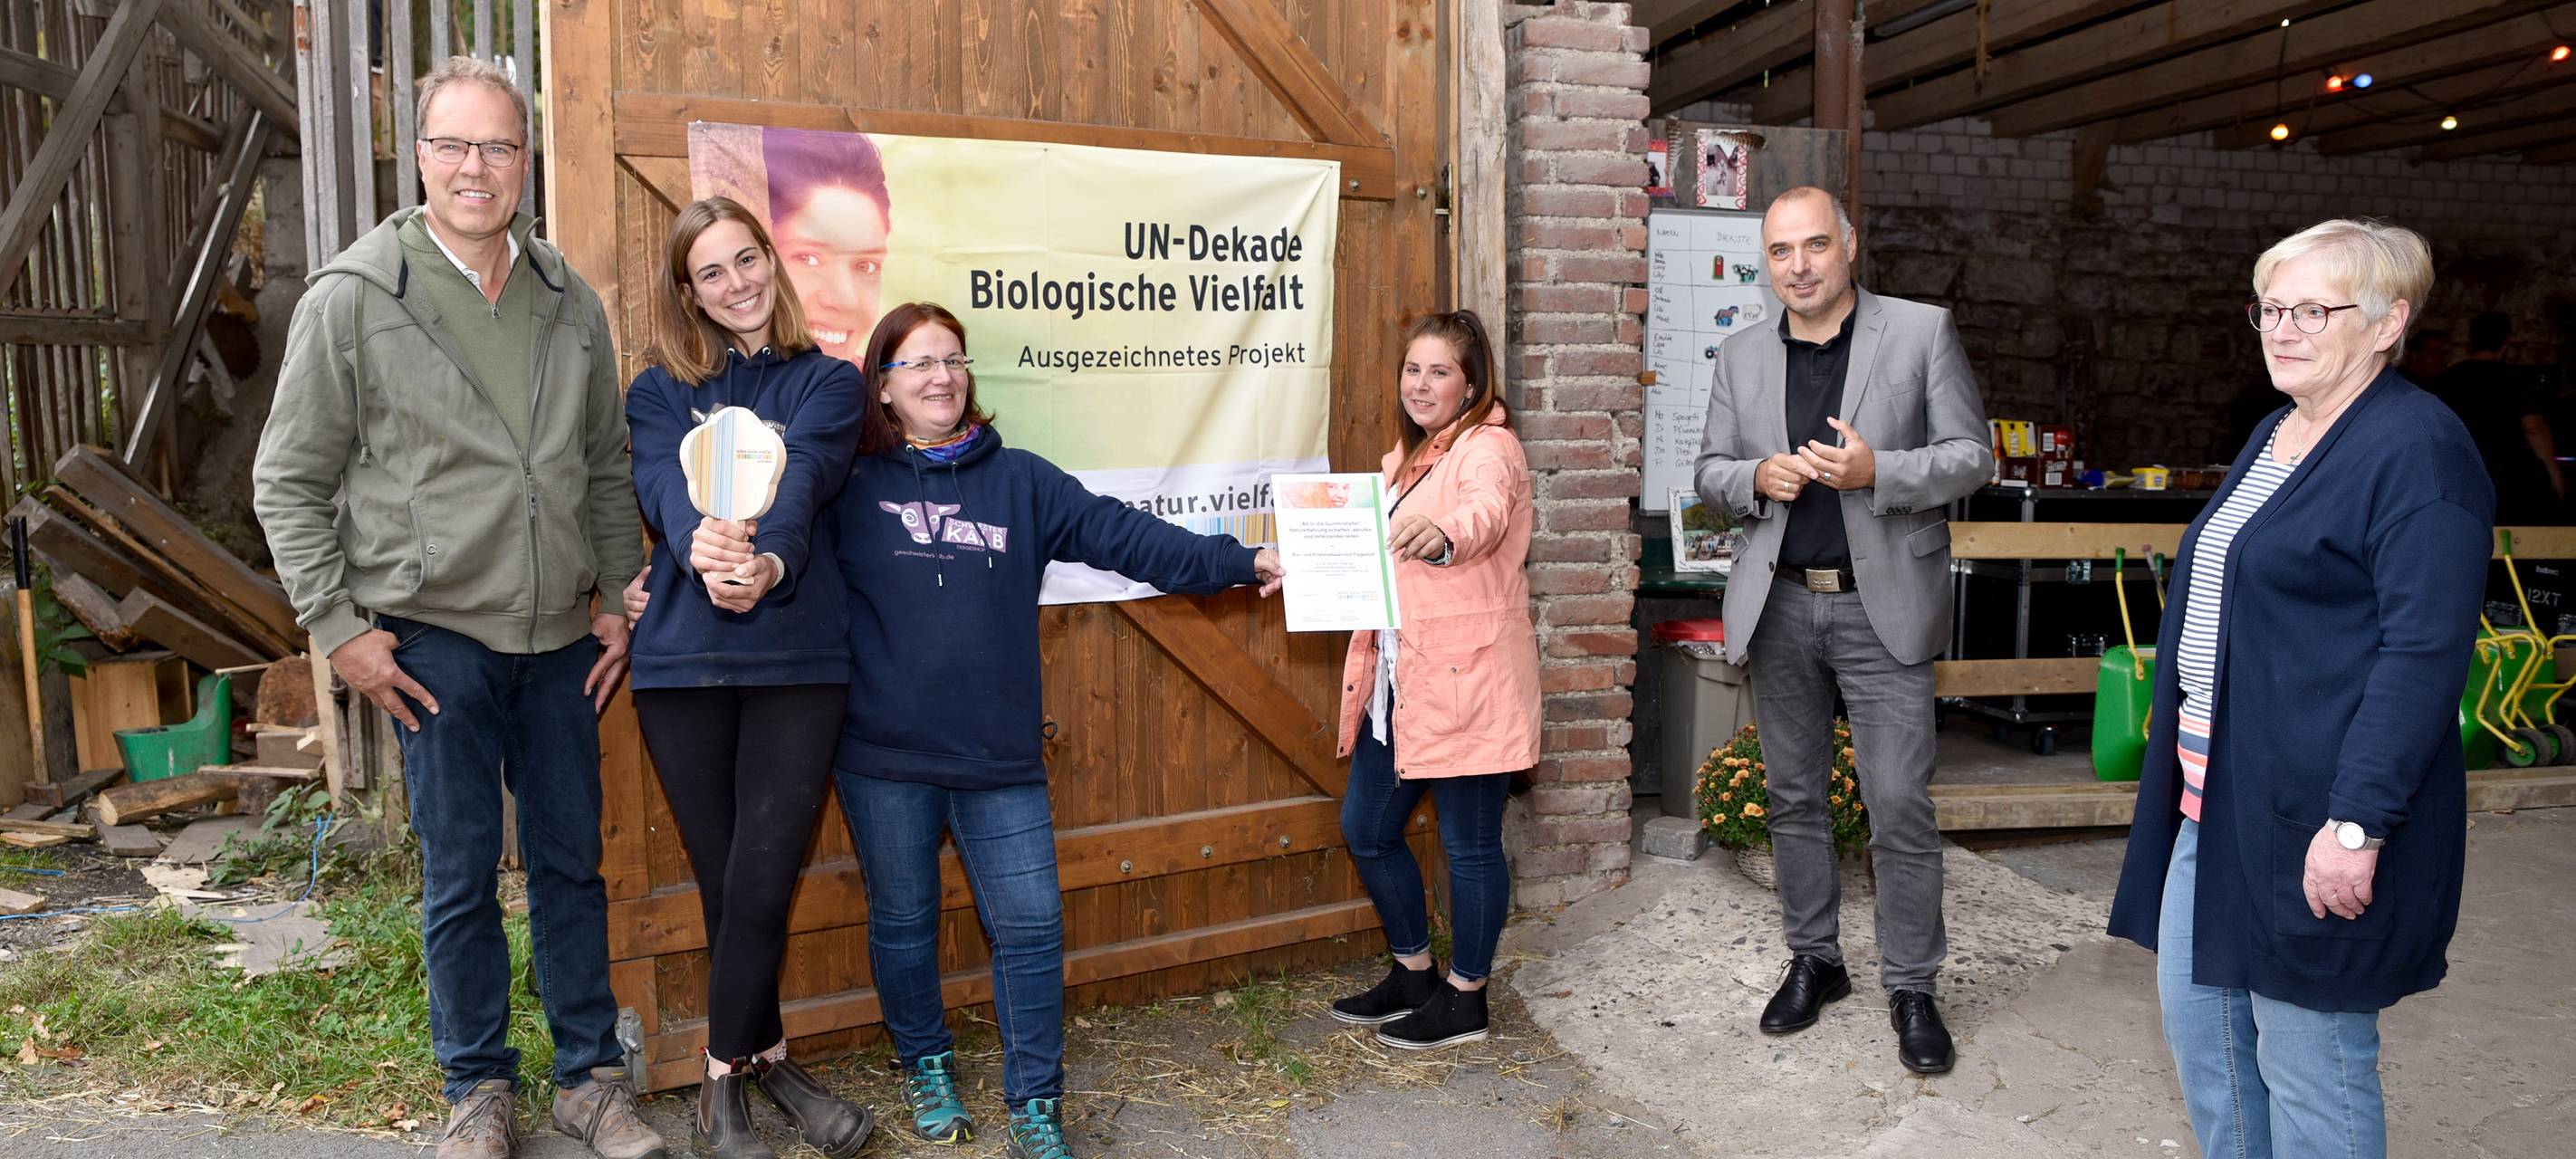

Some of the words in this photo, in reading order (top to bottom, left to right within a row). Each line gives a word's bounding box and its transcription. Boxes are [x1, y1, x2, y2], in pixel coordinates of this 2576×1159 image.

[1125, 222, 1302, 262] UN-Dekade
[971, 269, 1176, 320] Biologische
[1189, 273, 1304, 311] Vielfalt
[1018, 345, 1221, 372] Ausgezeichnetes
[1228, 342, 1306, 368] Projekt
[1124, 483, 1274, 516] atur.vielf
